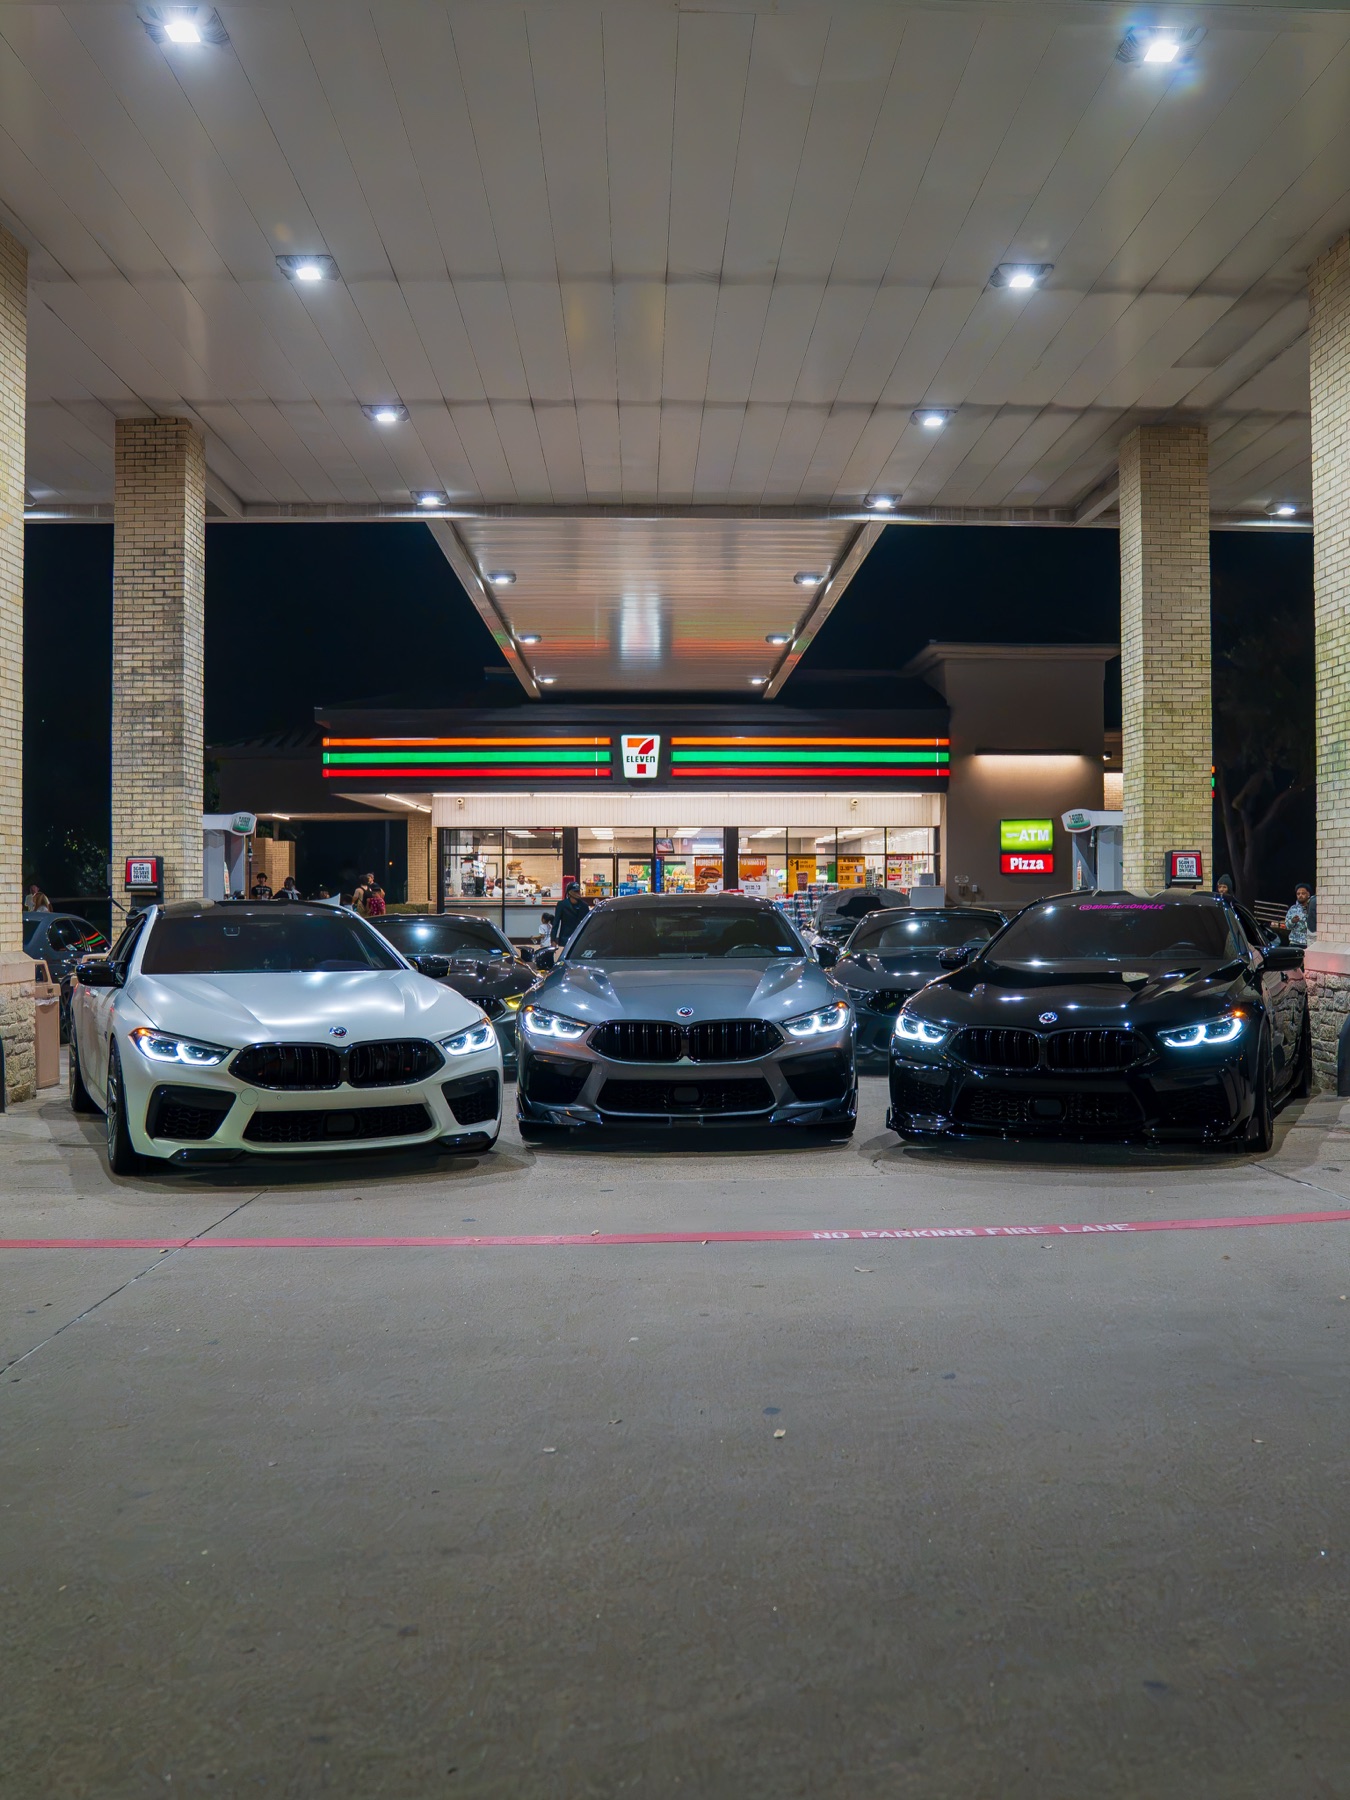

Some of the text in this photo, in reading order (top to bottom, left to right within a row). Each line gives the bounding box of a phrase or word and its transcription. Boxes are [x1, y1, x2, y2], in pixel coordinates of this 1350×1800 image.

[1019, 829, 1050, 841] ATM
[1010, 857, 1044, 870] Pizza
[813, 1223, 1137, 1240] NO PARKING FIRE LANE
